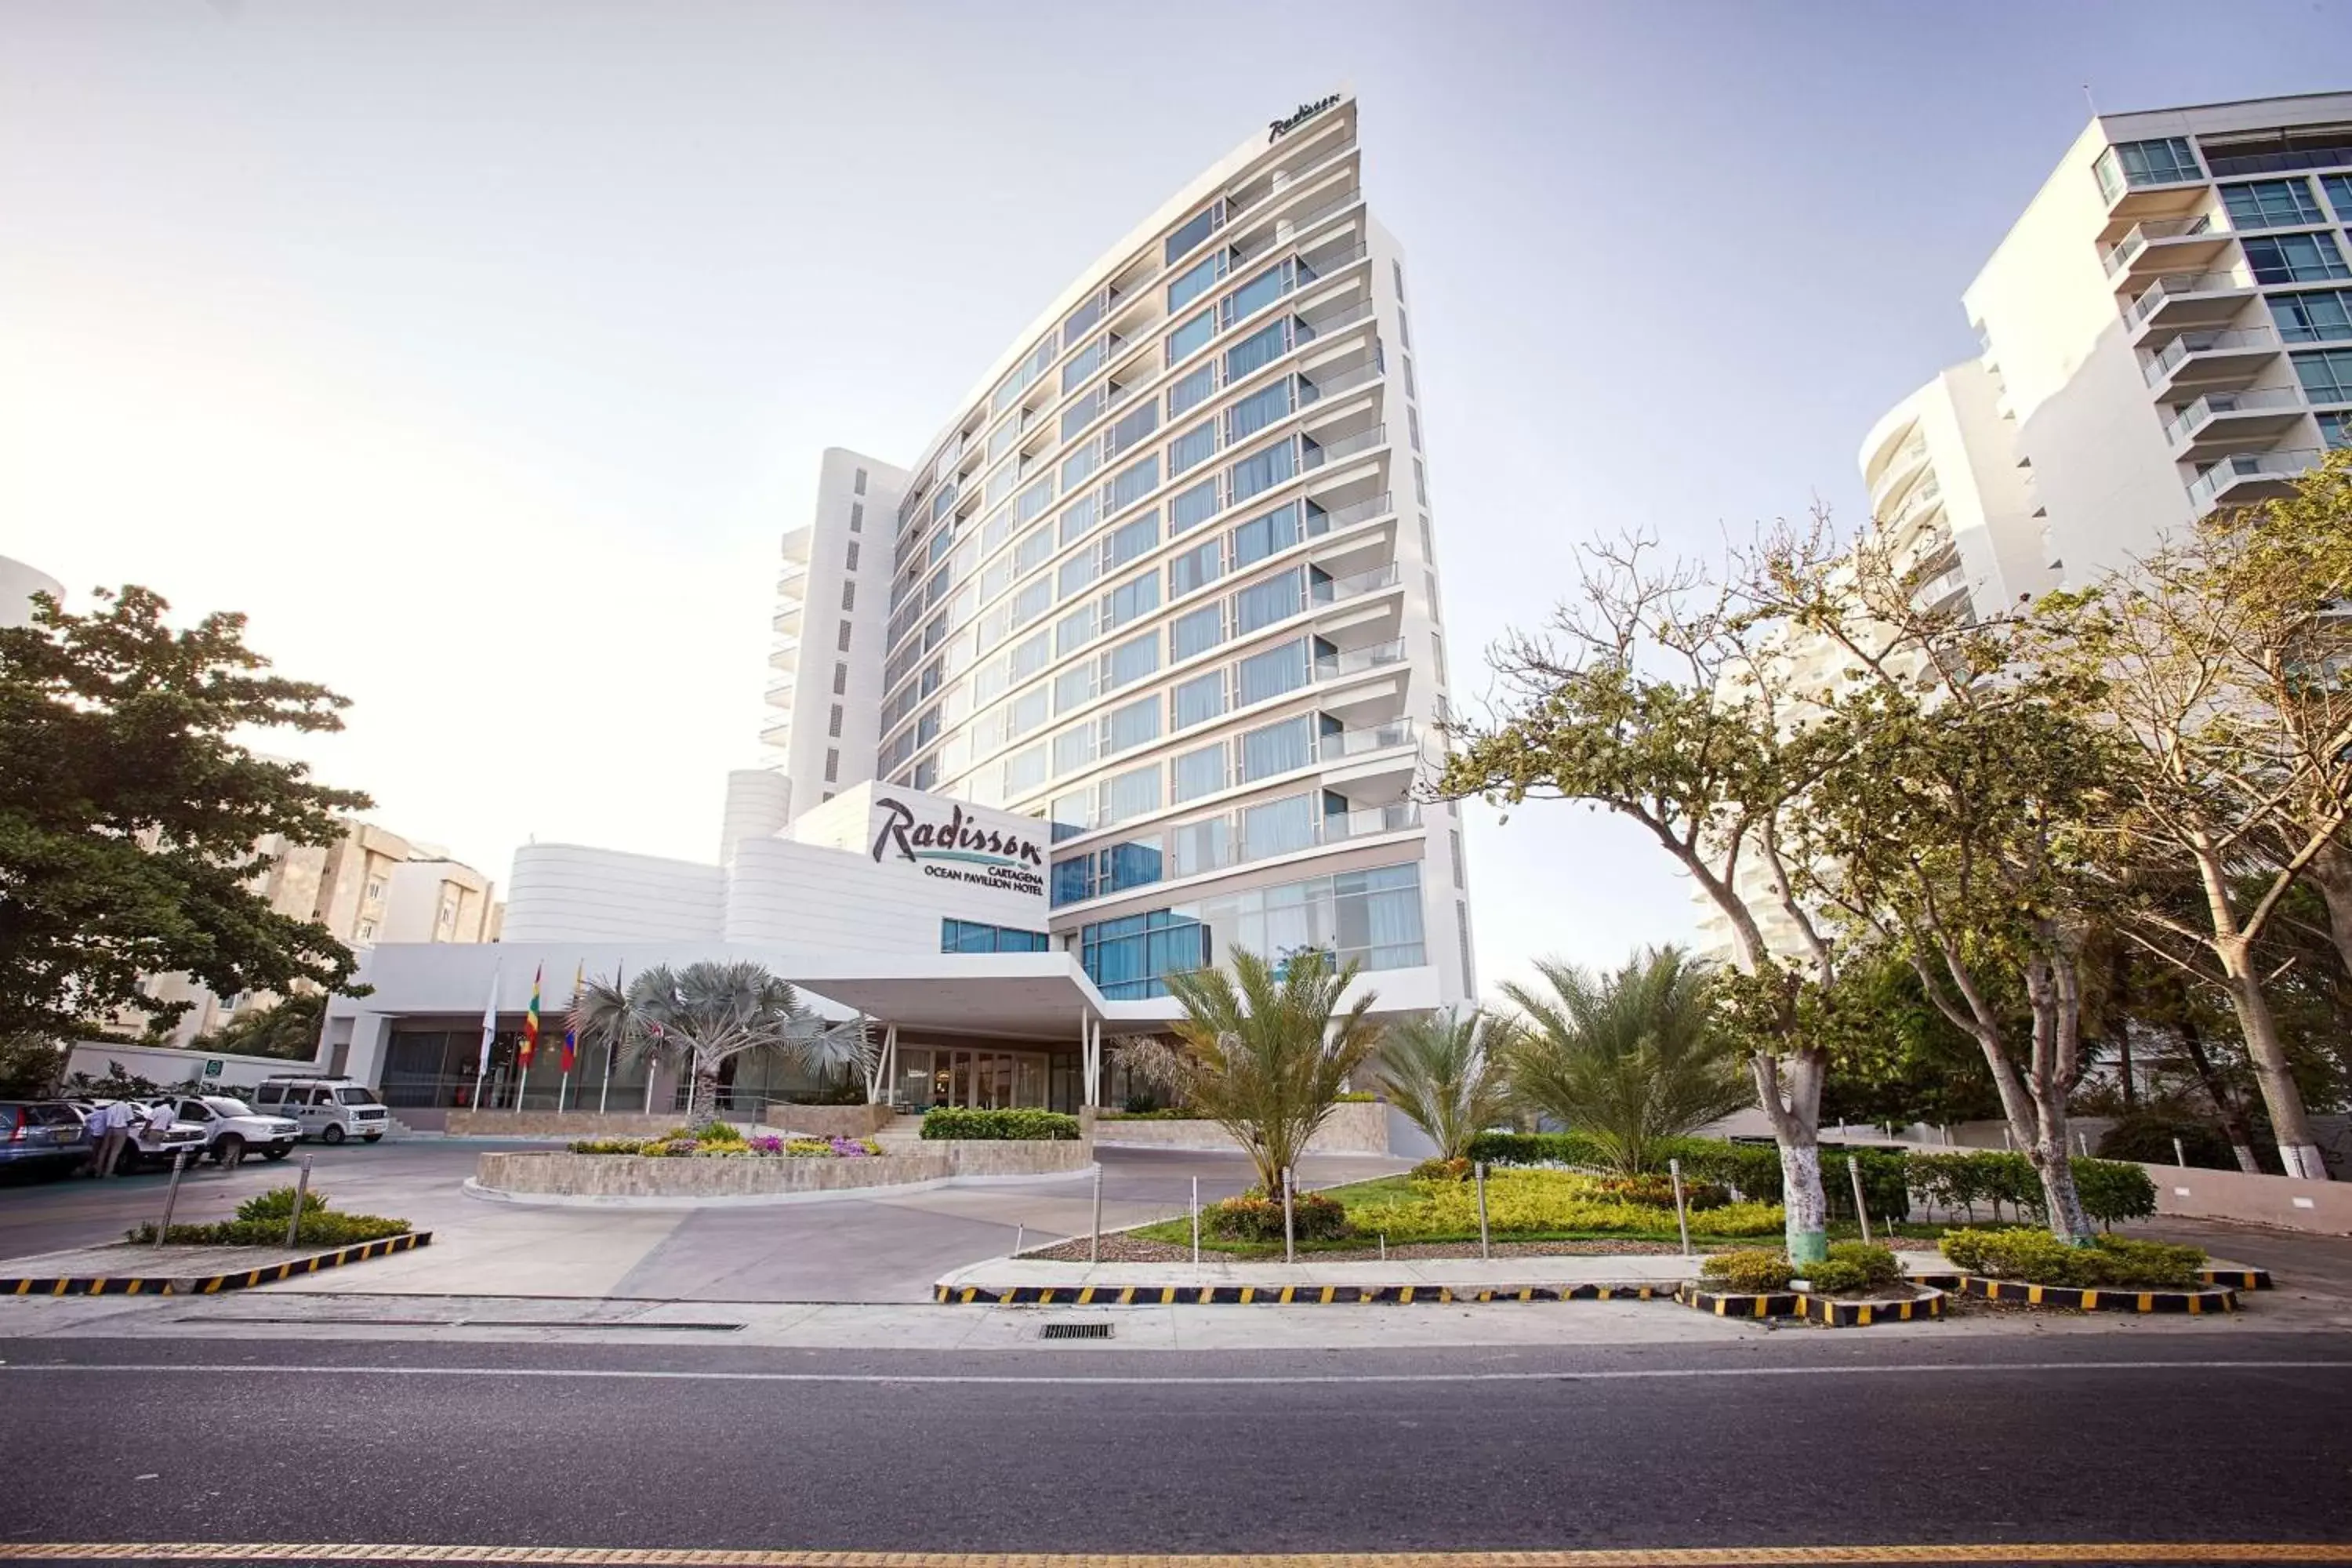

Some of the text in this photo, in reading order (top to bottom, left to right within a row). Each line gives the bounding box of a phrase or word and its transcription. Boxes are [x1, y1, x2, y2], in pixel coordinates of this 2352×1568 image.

[873, 797, 1042, 865] Radisson
[924, 865, 1044, 896] OCEAN PAVILLION HOTEL
[988, 866, 1044, 884] CARTAGENA
